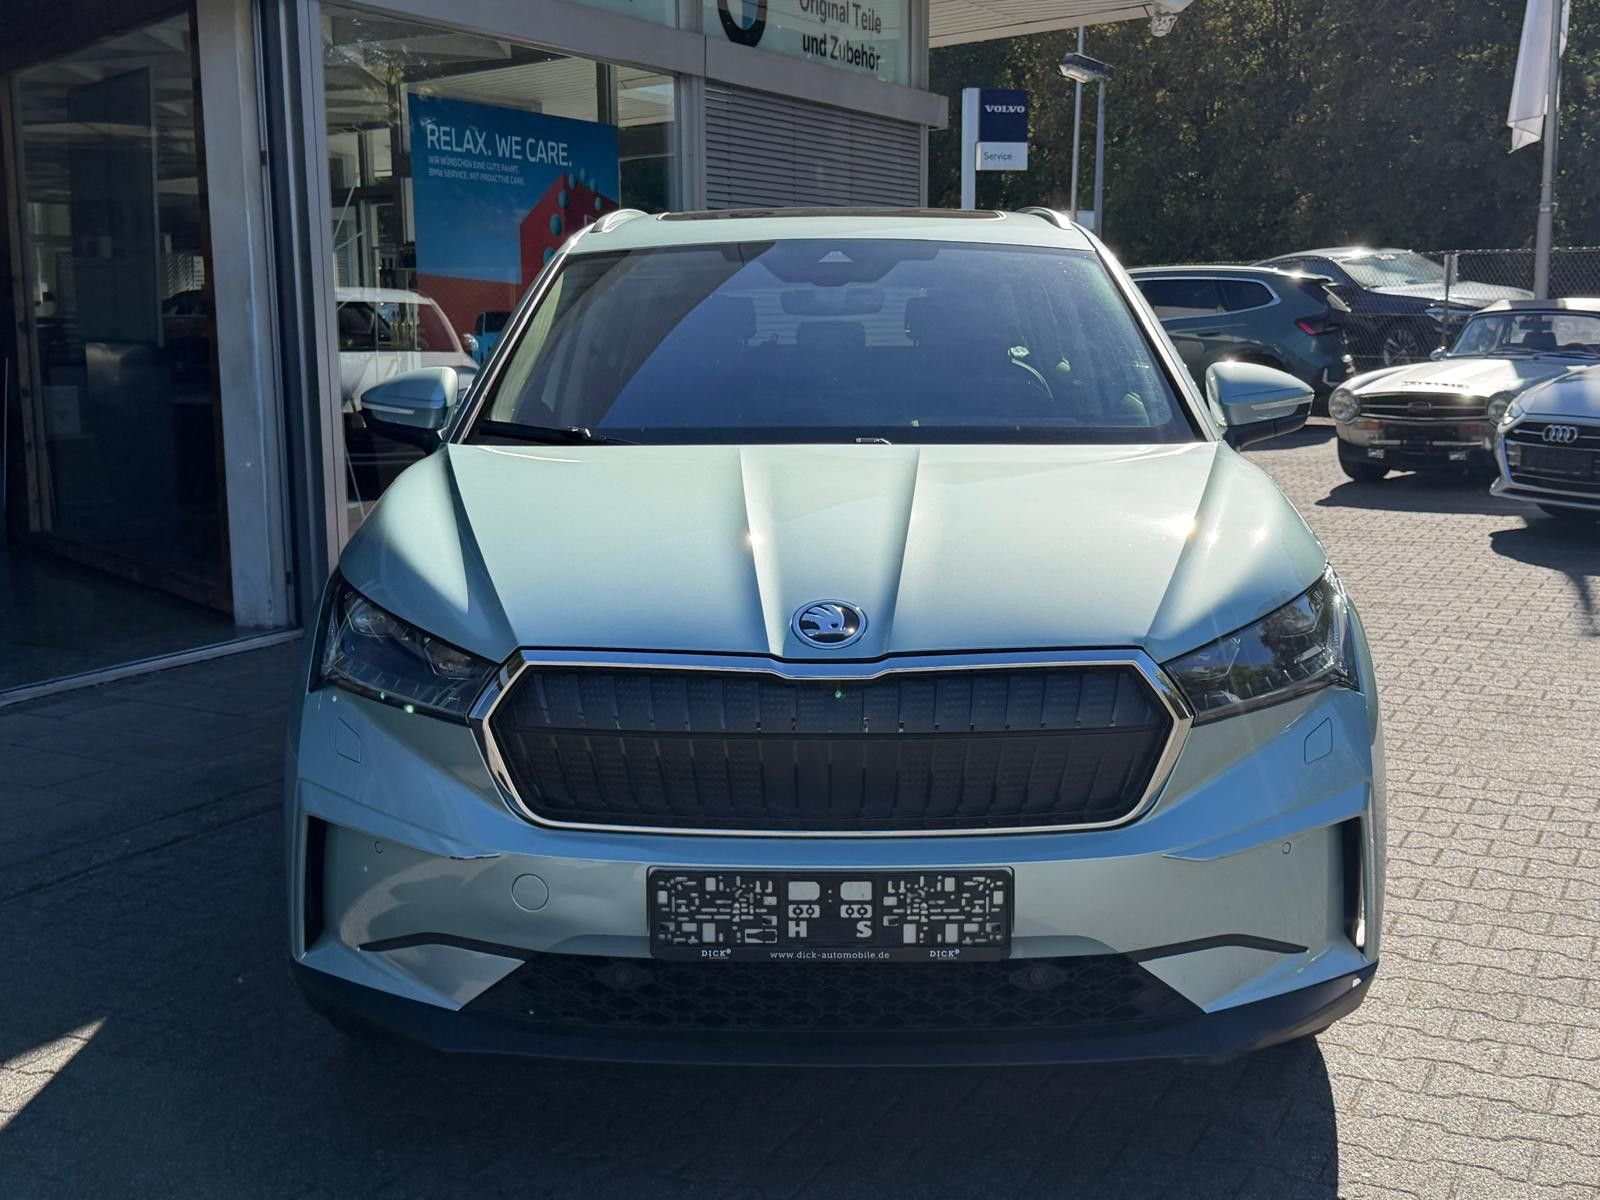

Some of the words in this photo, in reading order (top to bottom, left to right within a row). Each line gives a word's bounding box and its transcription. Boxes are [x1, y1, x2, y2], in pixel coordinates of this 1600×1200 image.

[800, 0, 849, 24] Original
[853, 3, 882, 33] Teile
[802, 33, 827, 57] und
[830, 35, 881, 71] Zubehör
[984, 105, 1026, 113] VOLVO
[426, 124, 492, 157] RELAX.
[495, 133, 523, 160] WE
[526, 138, 573, 167] CARE.
[983, 152, 1013, 160] Service
[473, 160, 486, 170] EINE
[487, 162, 500, 171] GUTE
[428, 167, 443, 177] BMW
[480, 172, 509, 184] PROACTIVE
[770, 951, 890, 959] www.dick-automobile.de
